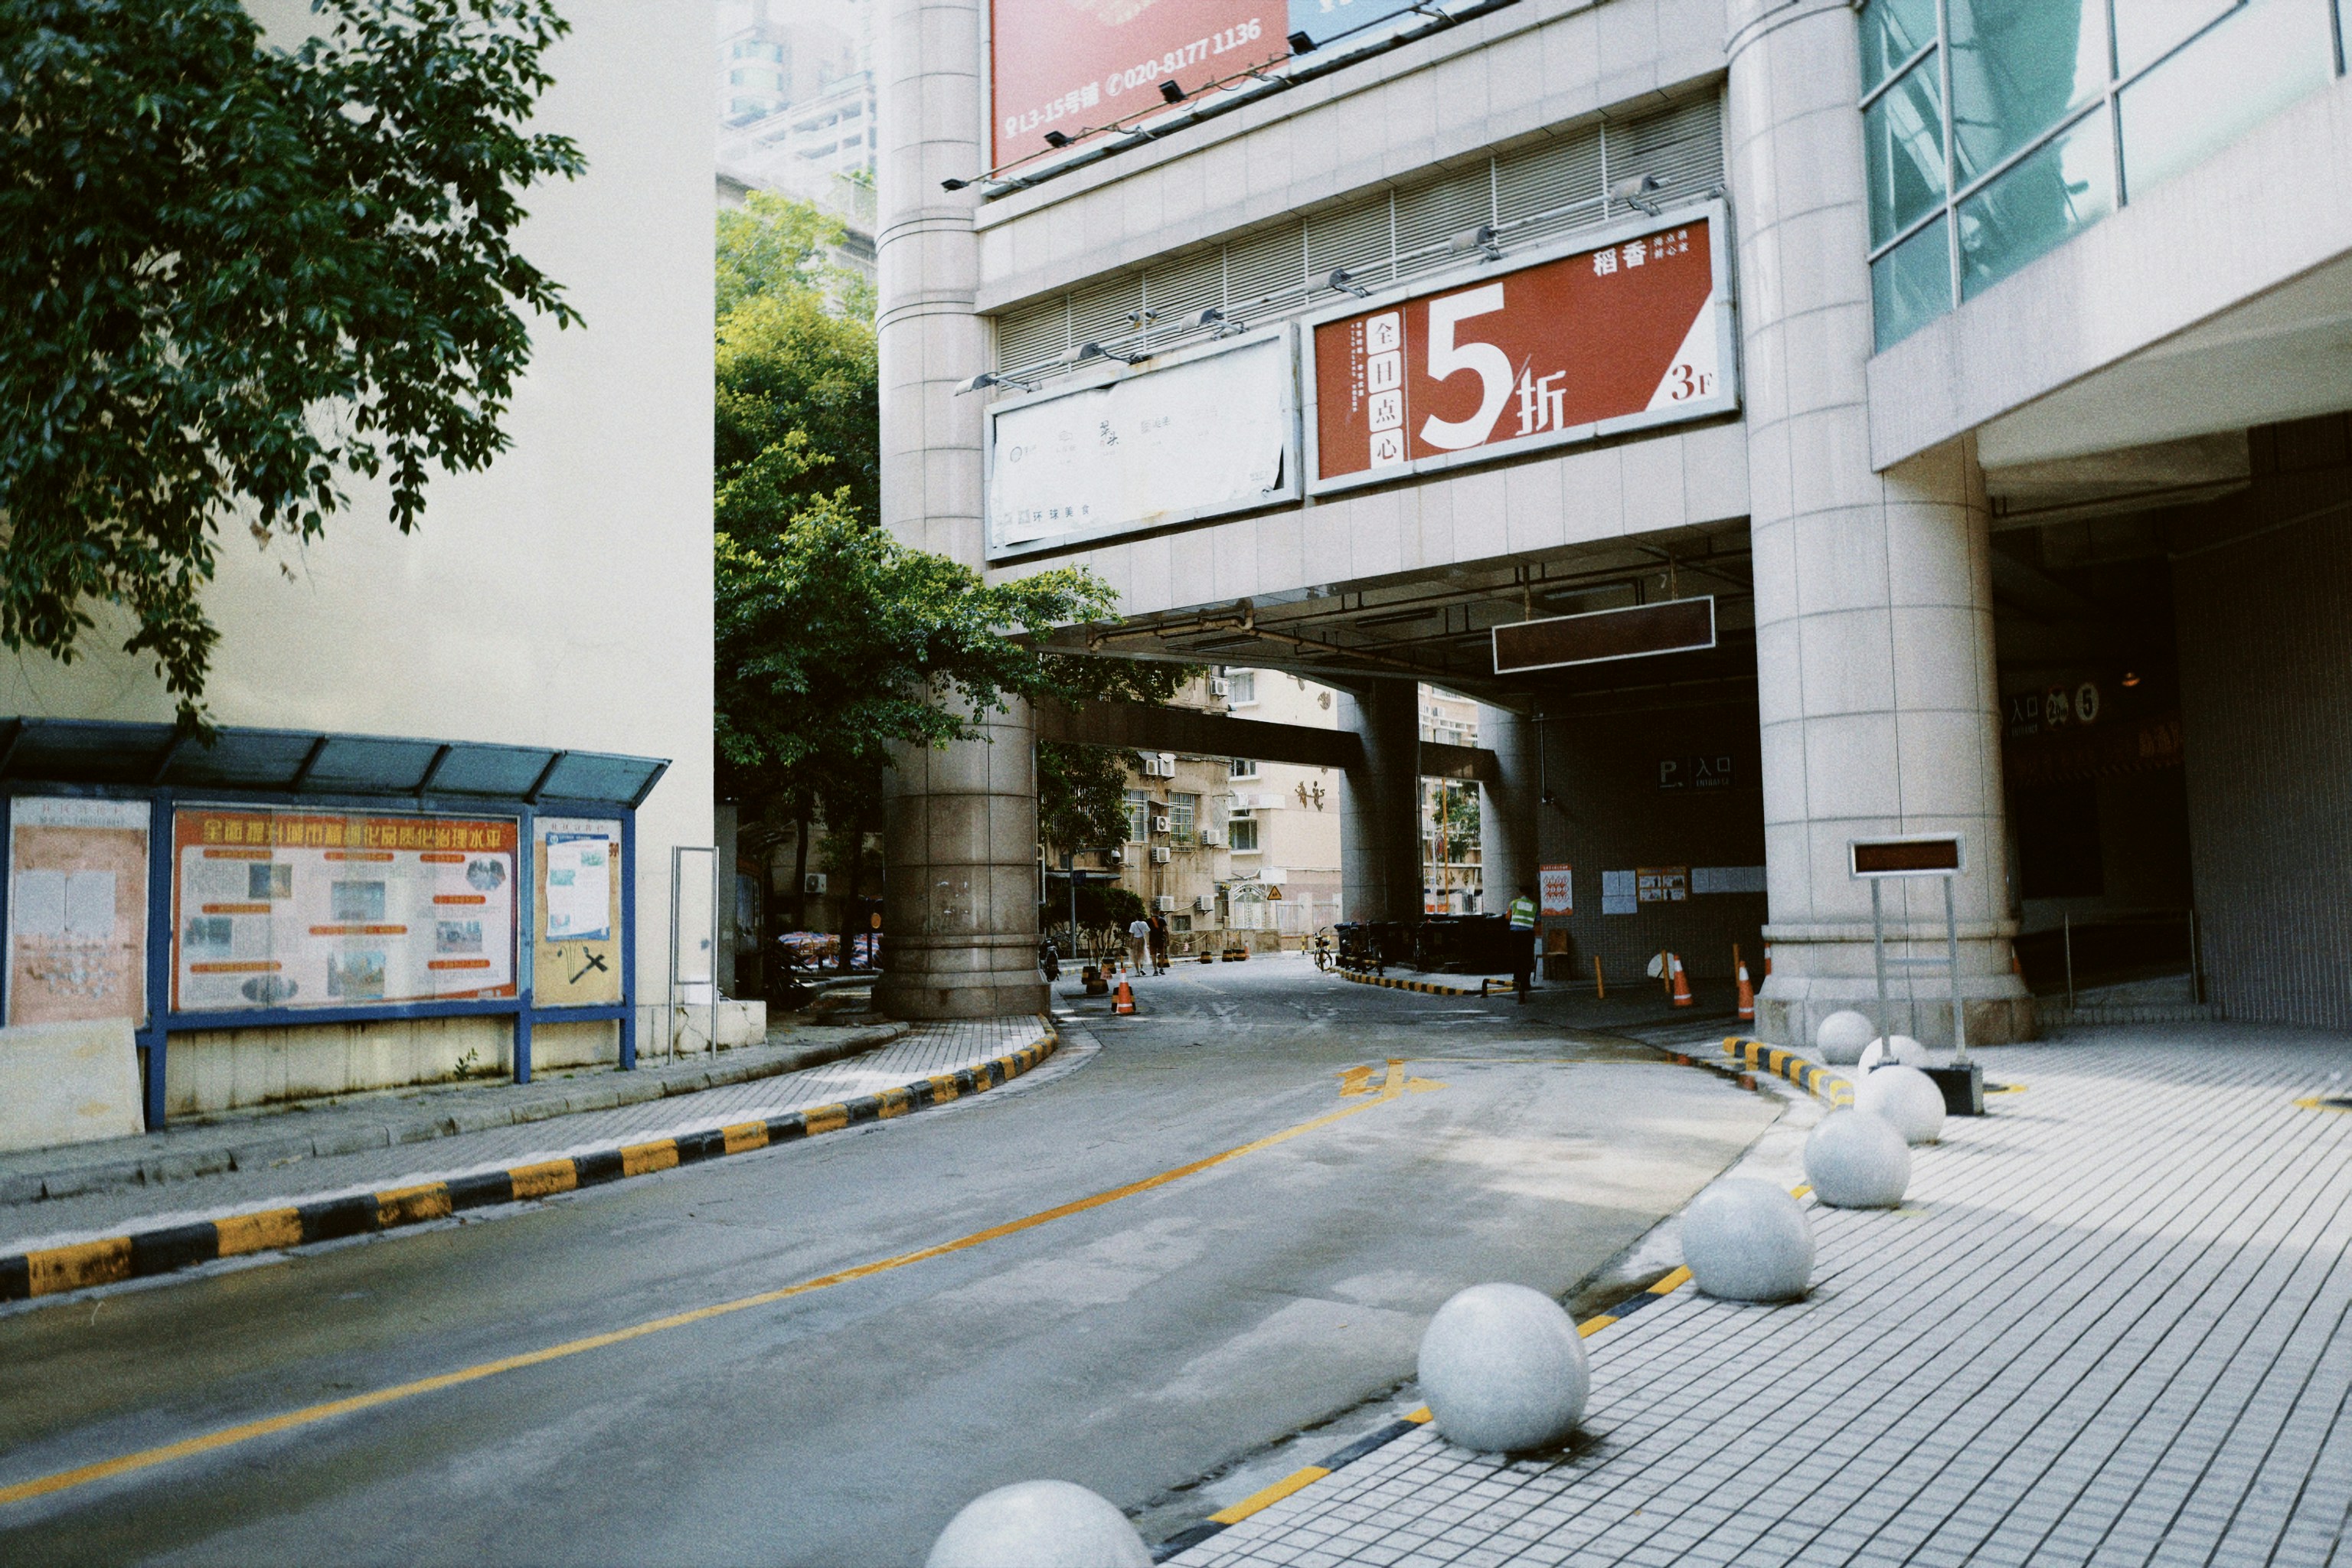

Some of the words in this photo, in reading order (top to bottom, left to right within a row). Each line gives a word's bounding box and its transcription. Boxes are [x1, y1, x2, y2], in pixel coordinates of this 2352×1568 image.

[1125, 38, 1207, 90] 020-8177
[1213, 18, 1263, 54] 1136
[1592, 239, 1647, 277] 稻香
[1375, 322, 1398, 461] 全日点心
[1671, 363, 1713, 401] 3F
[2082, 688, 2093, 718] 5
[1695, 756, 1731, 778] 入口
